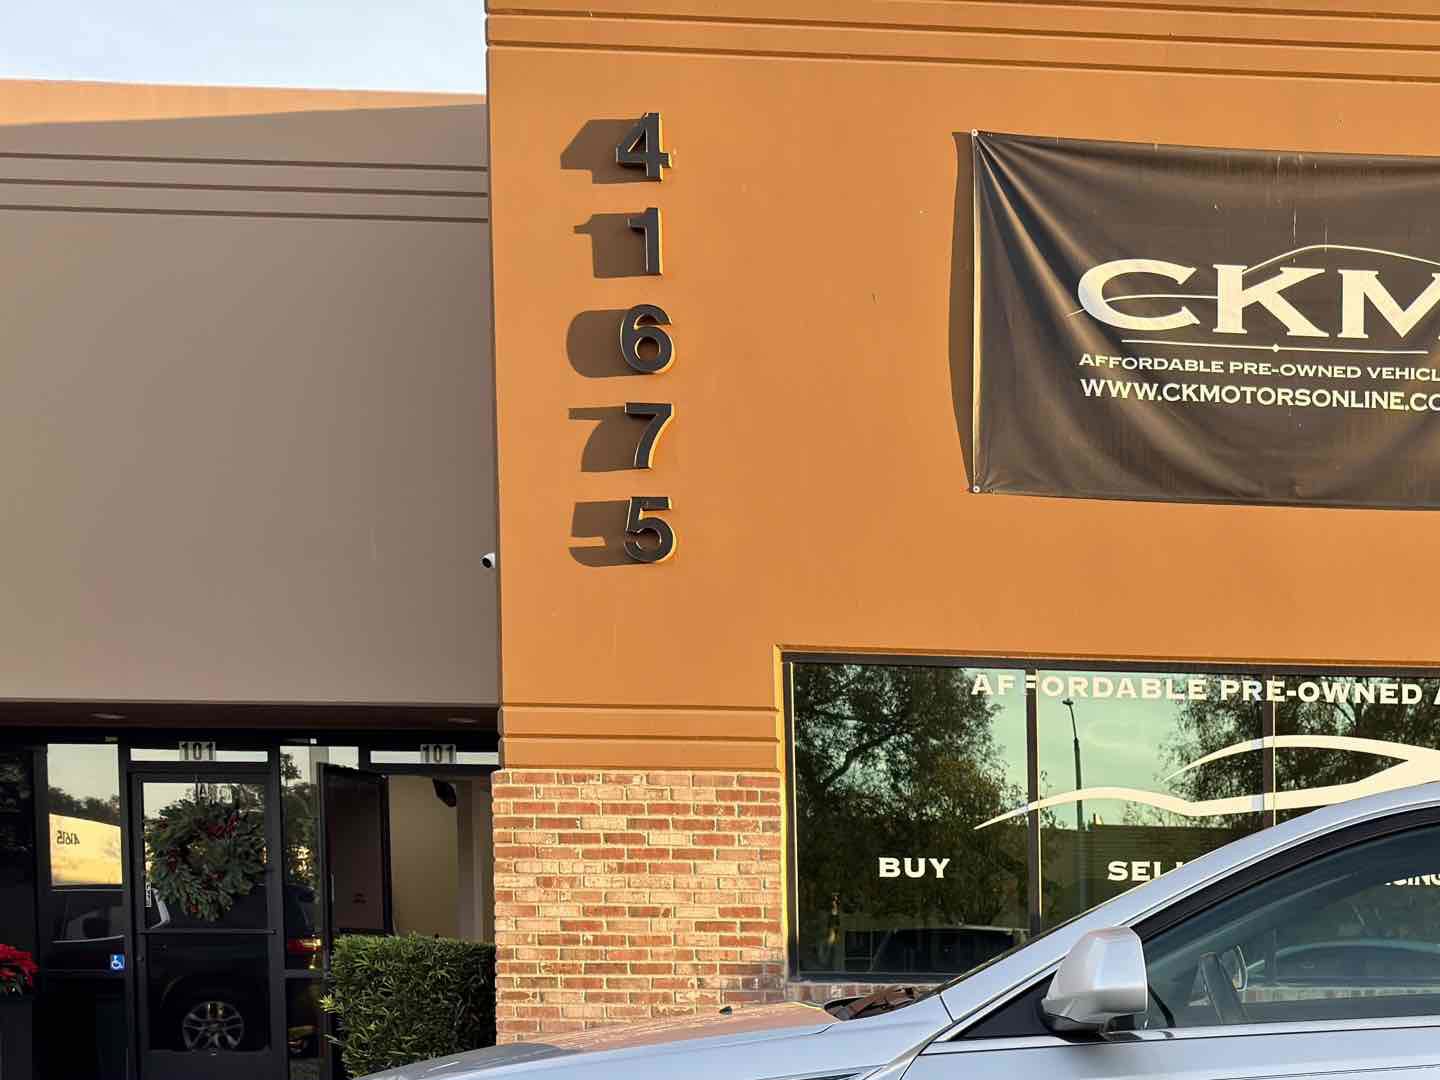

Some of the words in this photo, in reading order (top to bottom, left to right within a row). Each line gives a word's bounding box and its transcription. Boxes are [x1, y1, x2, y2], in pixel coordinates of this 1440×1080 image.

[615, 111, 676, 564] 41675
[1078, 353, 1225, 373] AFFORDABLE
[1229, 361, 1362, 379] PRE-OWNED
[970, 674, 1208, 701] AFFORDABLE
[1220, 680, 1423, 705] PRE-OWNED
[180, 743, 214, 761] 101
[422, 745, 454, 762] 101
[879, 857, 951, 878] BUY
[1107, 861, 1184, 881] SEL
